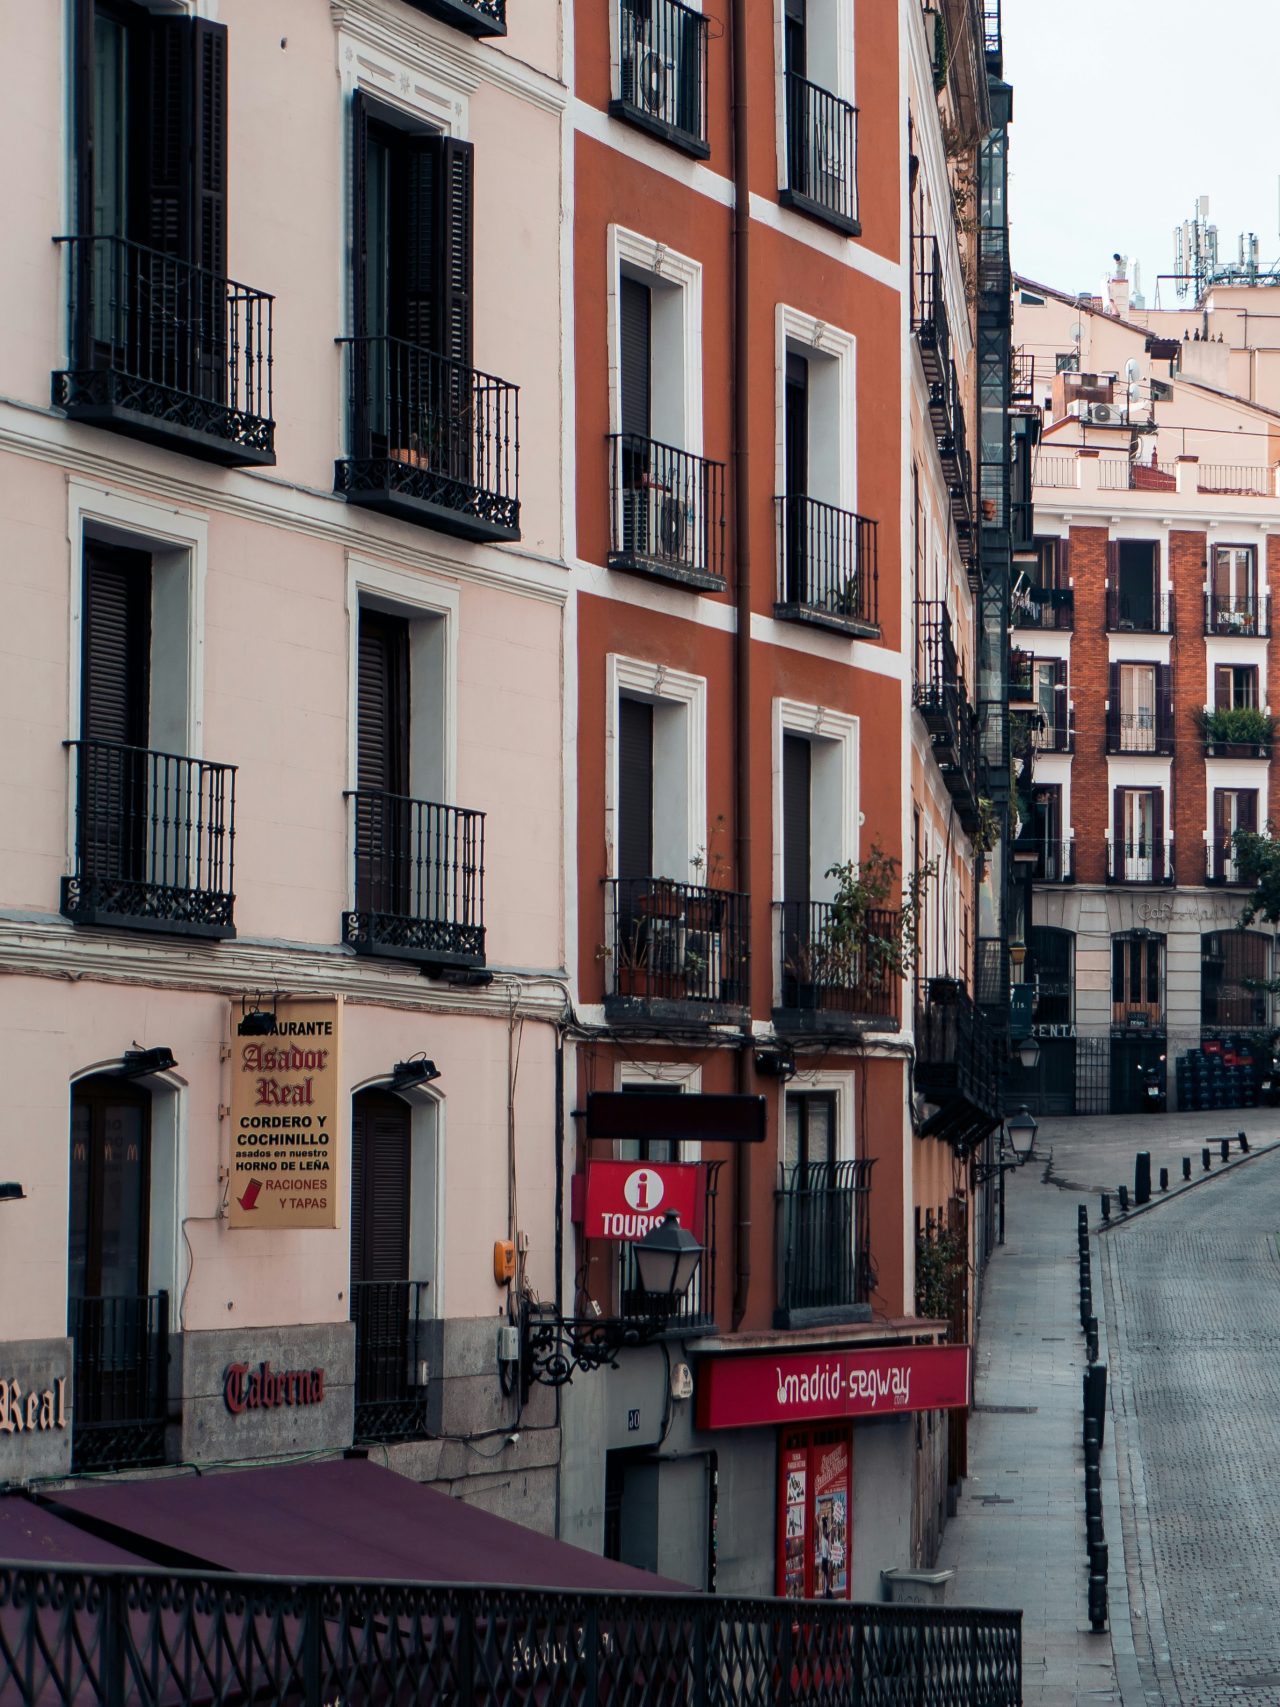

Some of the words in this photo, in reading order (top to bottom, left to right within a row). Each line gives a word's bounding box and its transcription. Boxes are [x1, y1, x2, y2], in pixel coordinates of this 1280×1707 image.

[238, 1021, 332, 1036] RAURANTE
[242, 1041, 329, 1073] Asador
[255, 1076, 315, 1107] Real
[240, 1116, 312, 1128] CORDERO
[317, 1116, 327, 1128] Y
[237, 1133, 329, 1145] COCHINILLO
[236, 1149, 271, 1158] asados
[289, 1150, 328, 1158] nuestro
[236, 1161, 277, 1171] HORNO
[281, 1161, 296, 1171] DE
[299, 1159, 330, 1171] LEÑA
[266, 1179, 328, 1190] RACIONES
[279, 1198, 287, 1209] Y
[289, 1198, 327, 1209] TAPAS
[602, 1213, 681, 1237] TOURIS
[223, 1361, 325, 1414] Taberna
